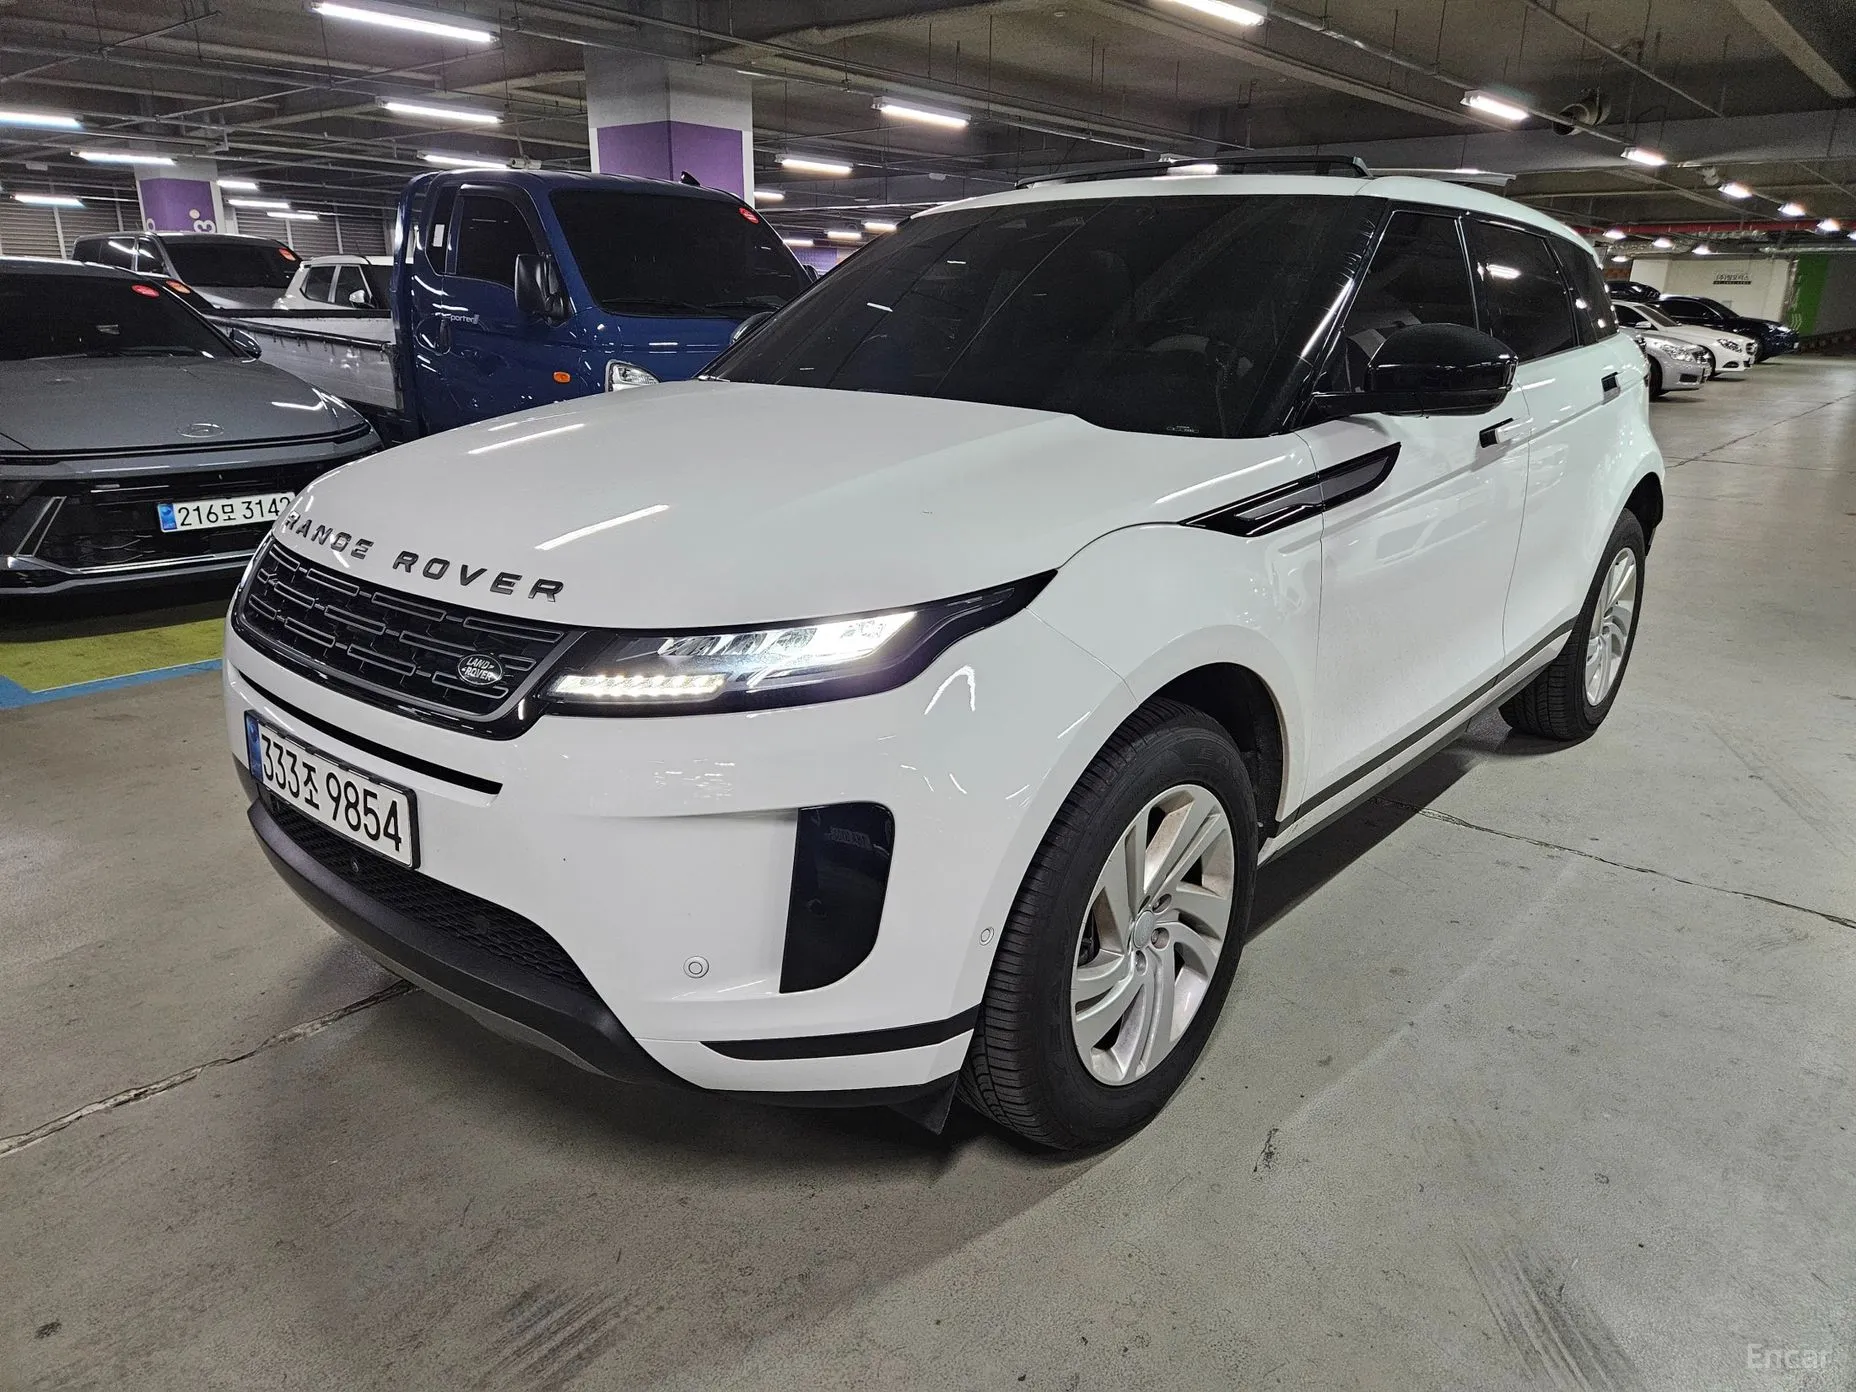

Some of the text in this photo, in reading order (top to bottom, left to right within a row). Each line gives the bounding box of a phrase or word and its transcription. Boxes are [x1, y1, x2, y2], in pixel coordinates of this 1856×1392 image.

[178, 504, 236, 526] 216모
[284, 511, 564, 602] RANGE ROVER
[464, 666, 494, 681] ROVER
[466, 657, 490, 669] LAND
[261, 734, 402, 852] 333조 9854
